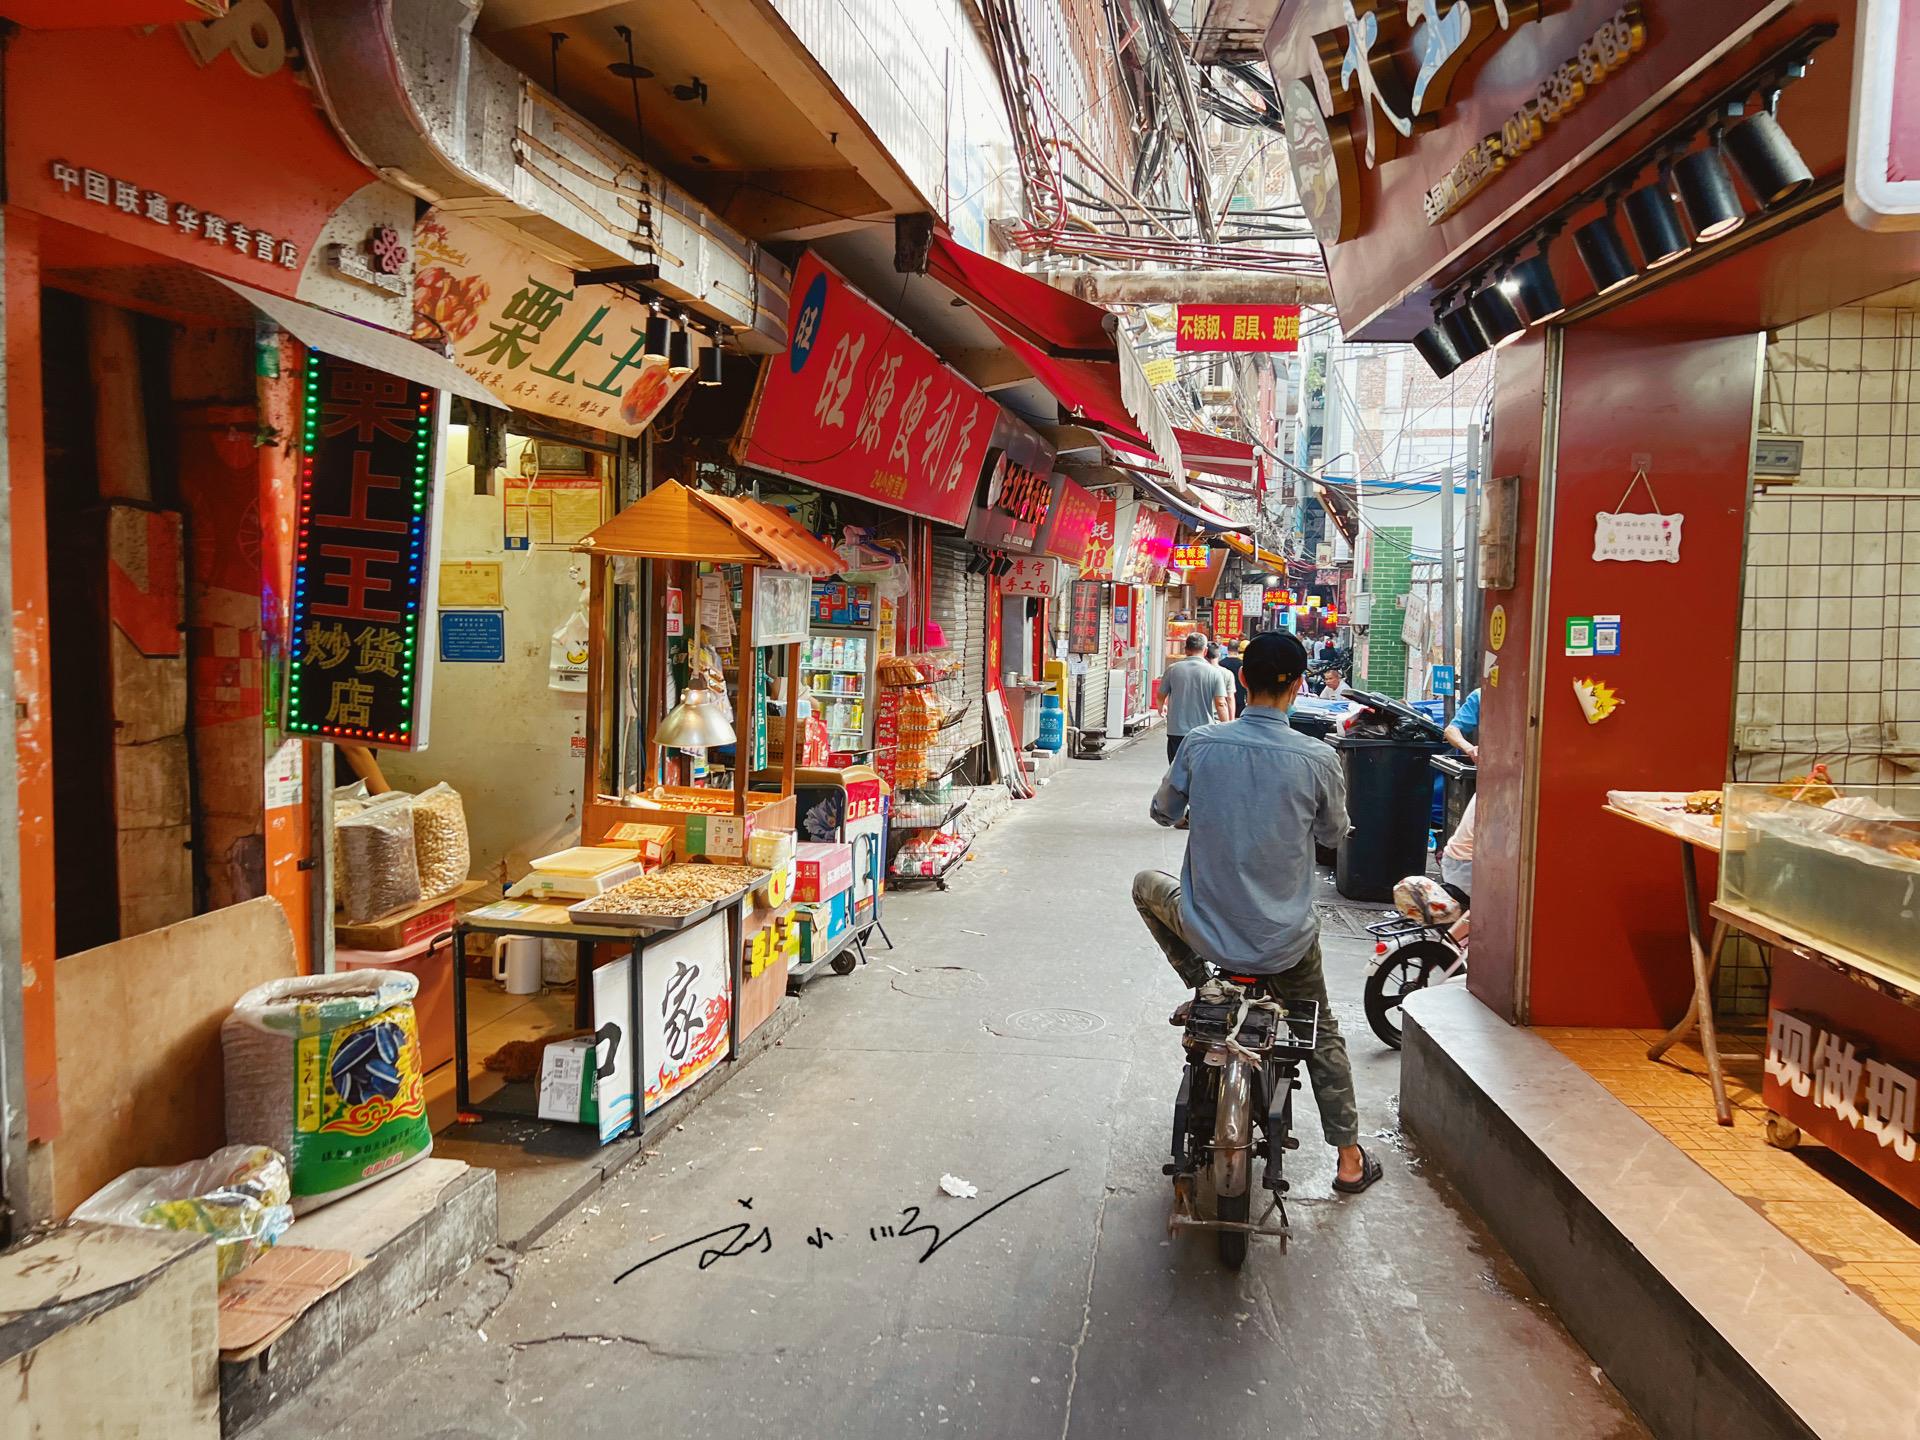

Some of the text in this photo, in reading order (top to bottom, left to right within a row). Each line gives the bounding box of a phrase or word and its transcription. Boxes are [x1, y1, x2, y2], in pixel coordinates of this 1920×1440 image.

[52, 162, 299, 270] 中国联通华辉专营店
[463, 274, 647, 397] 栗上王
[796, 305, 819, 351] 旺
[1181, 314, 1300, 341] 不锈钢、厨具、玻璃
[814, 332, 980, 494] 旺源便利店
[1005, 576, 1051, 596] 手工面
[1012, 559, 1046, 577] 普宁
[1084, 547, 1107, 570] 18
[303, 620, 403, 678] 炒货
[325, 677, 375, 729] 店
[661, 961, 704, 1060] 家
[1764, 1008, 1919, 1163] 现做现
